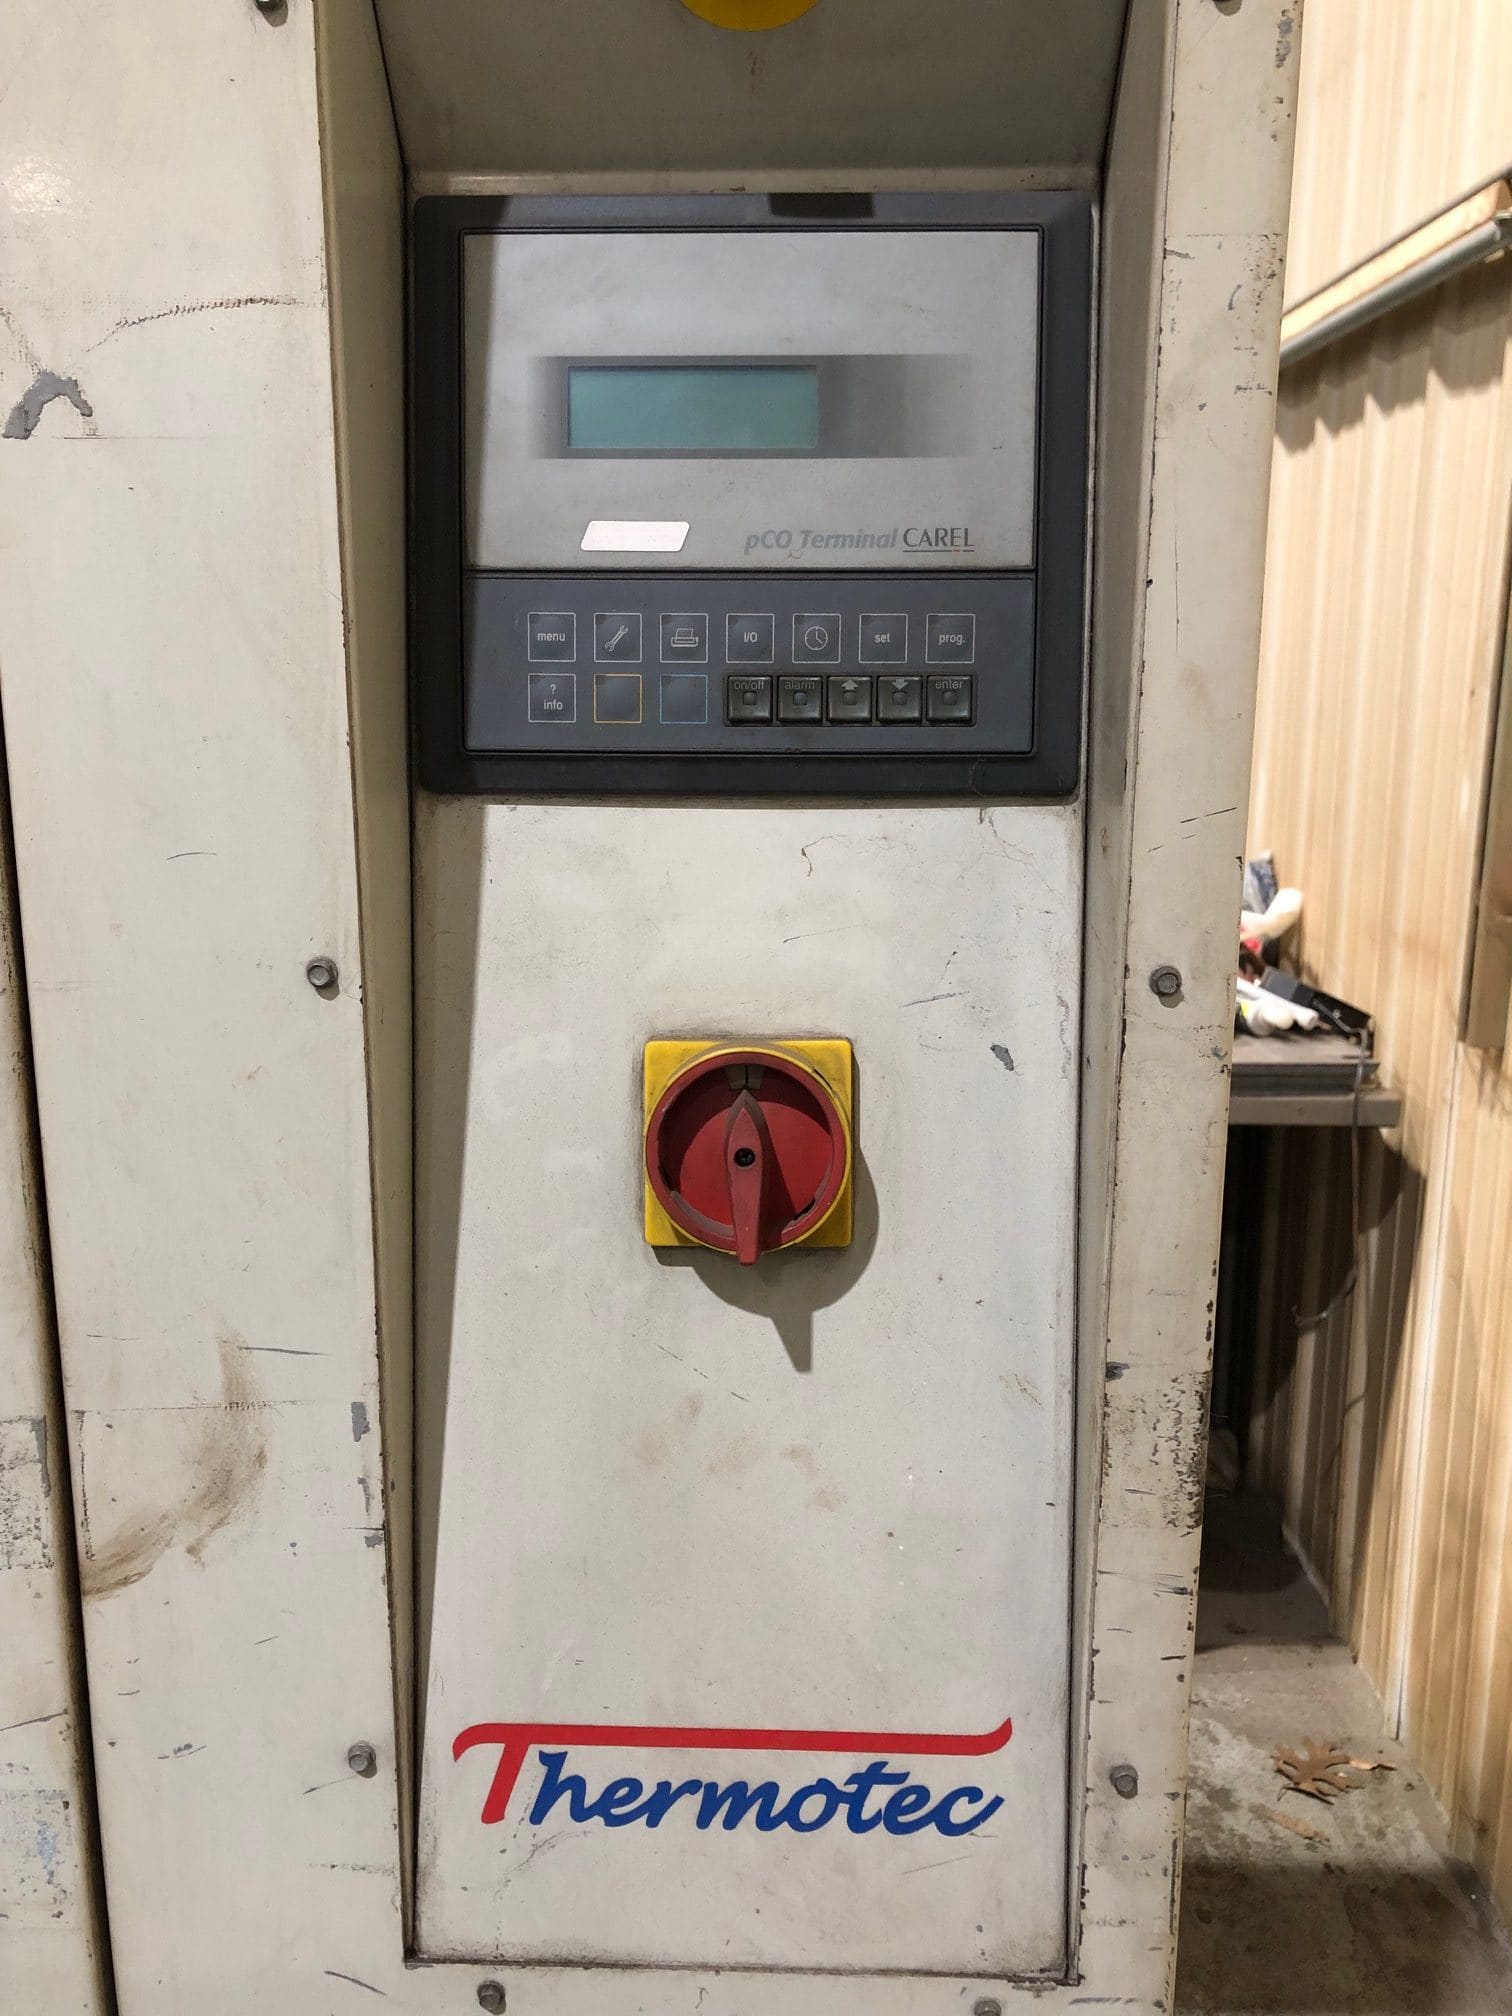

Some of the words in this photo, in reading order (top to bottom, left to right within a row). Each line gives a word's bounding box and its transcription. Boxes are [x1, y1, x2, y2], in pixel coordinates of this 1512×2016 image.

[744, 529, 792, 555] pCO
[799, 528, 899, 550] Terminal
[902, 527, 976, 548] CAREL
[537, 632, 566, 642] menu
[743, 631, 758, 643] I/O
[874, 632, 891, 643] set
[938, 633, 966, 646] prog.
[550, 684, 557, 695] ?
[734, 680, 765, 691] on/off
[784, 680, 815, 690] alarm
[935, 680, 964, 690] enter
[543, 699, 563, 711] info
[452, 1717, 1013, 1837] Thermotec
